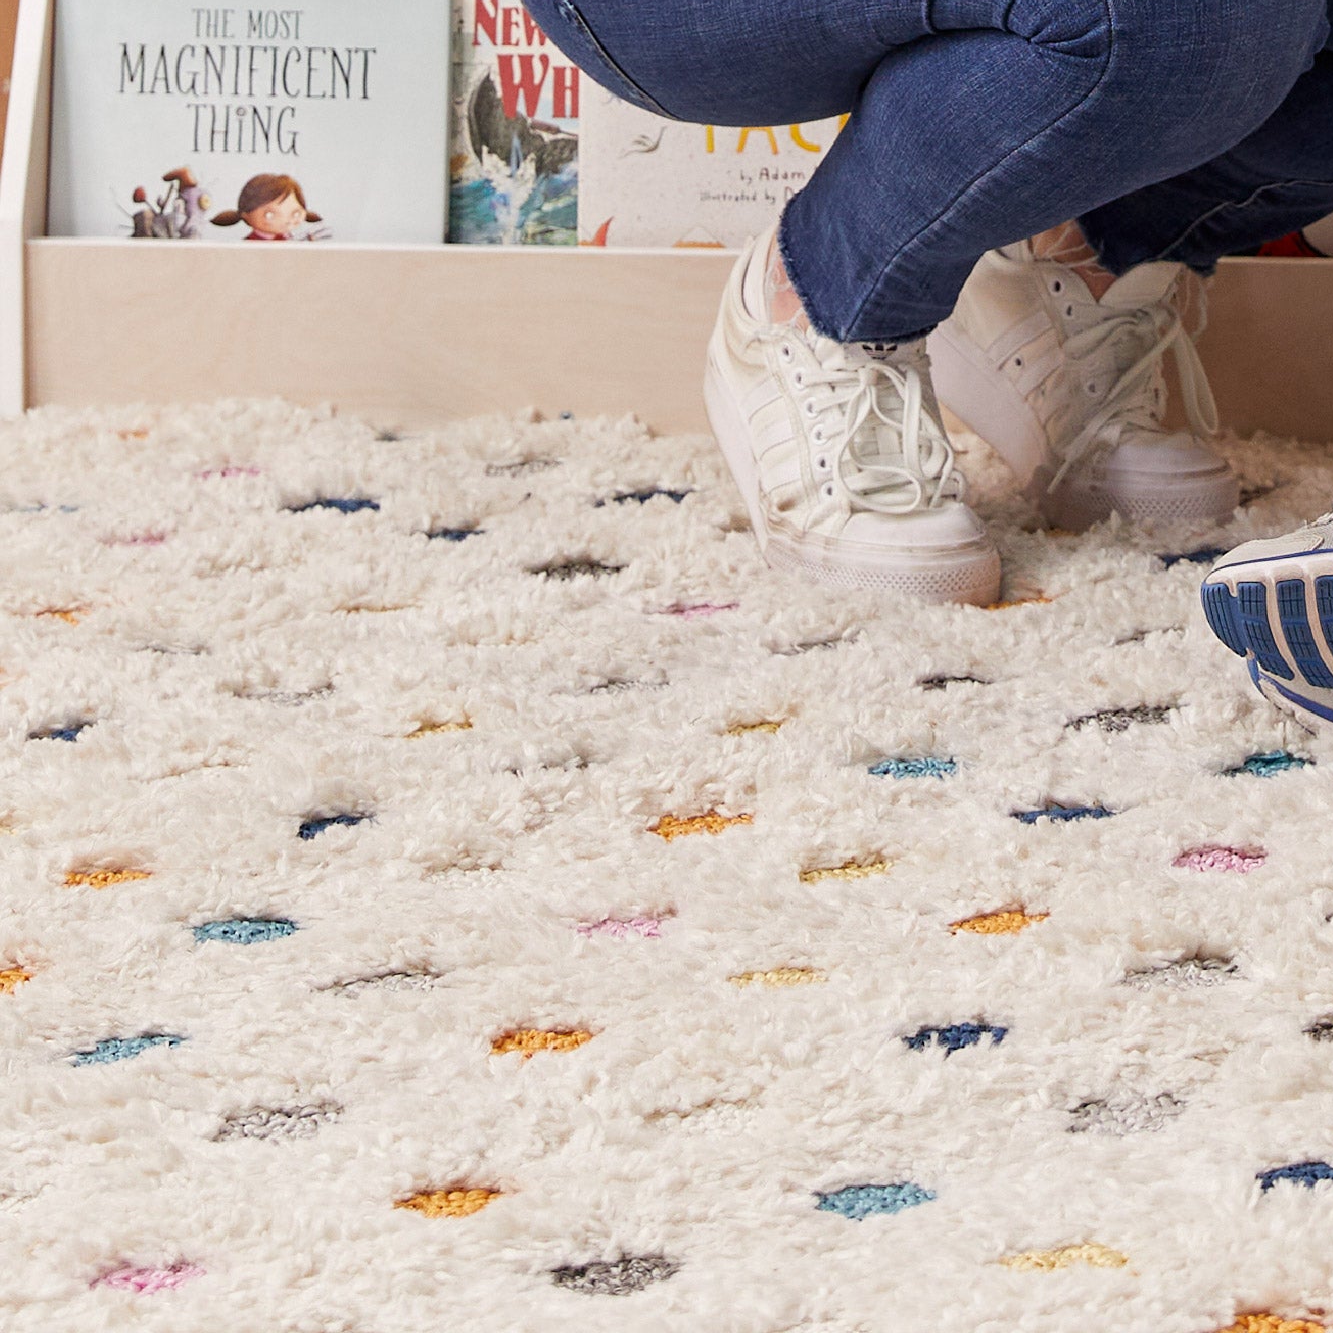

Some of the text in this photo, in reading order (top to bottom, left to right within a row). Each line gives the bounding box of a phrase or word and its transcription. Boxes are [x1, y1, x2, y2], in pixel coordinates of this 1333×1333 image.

[191, 8, 304, 40] THE MOST
[118, 41, 378, 101] MAGNIFICENT
[758, 167, 806, 181] Adam
